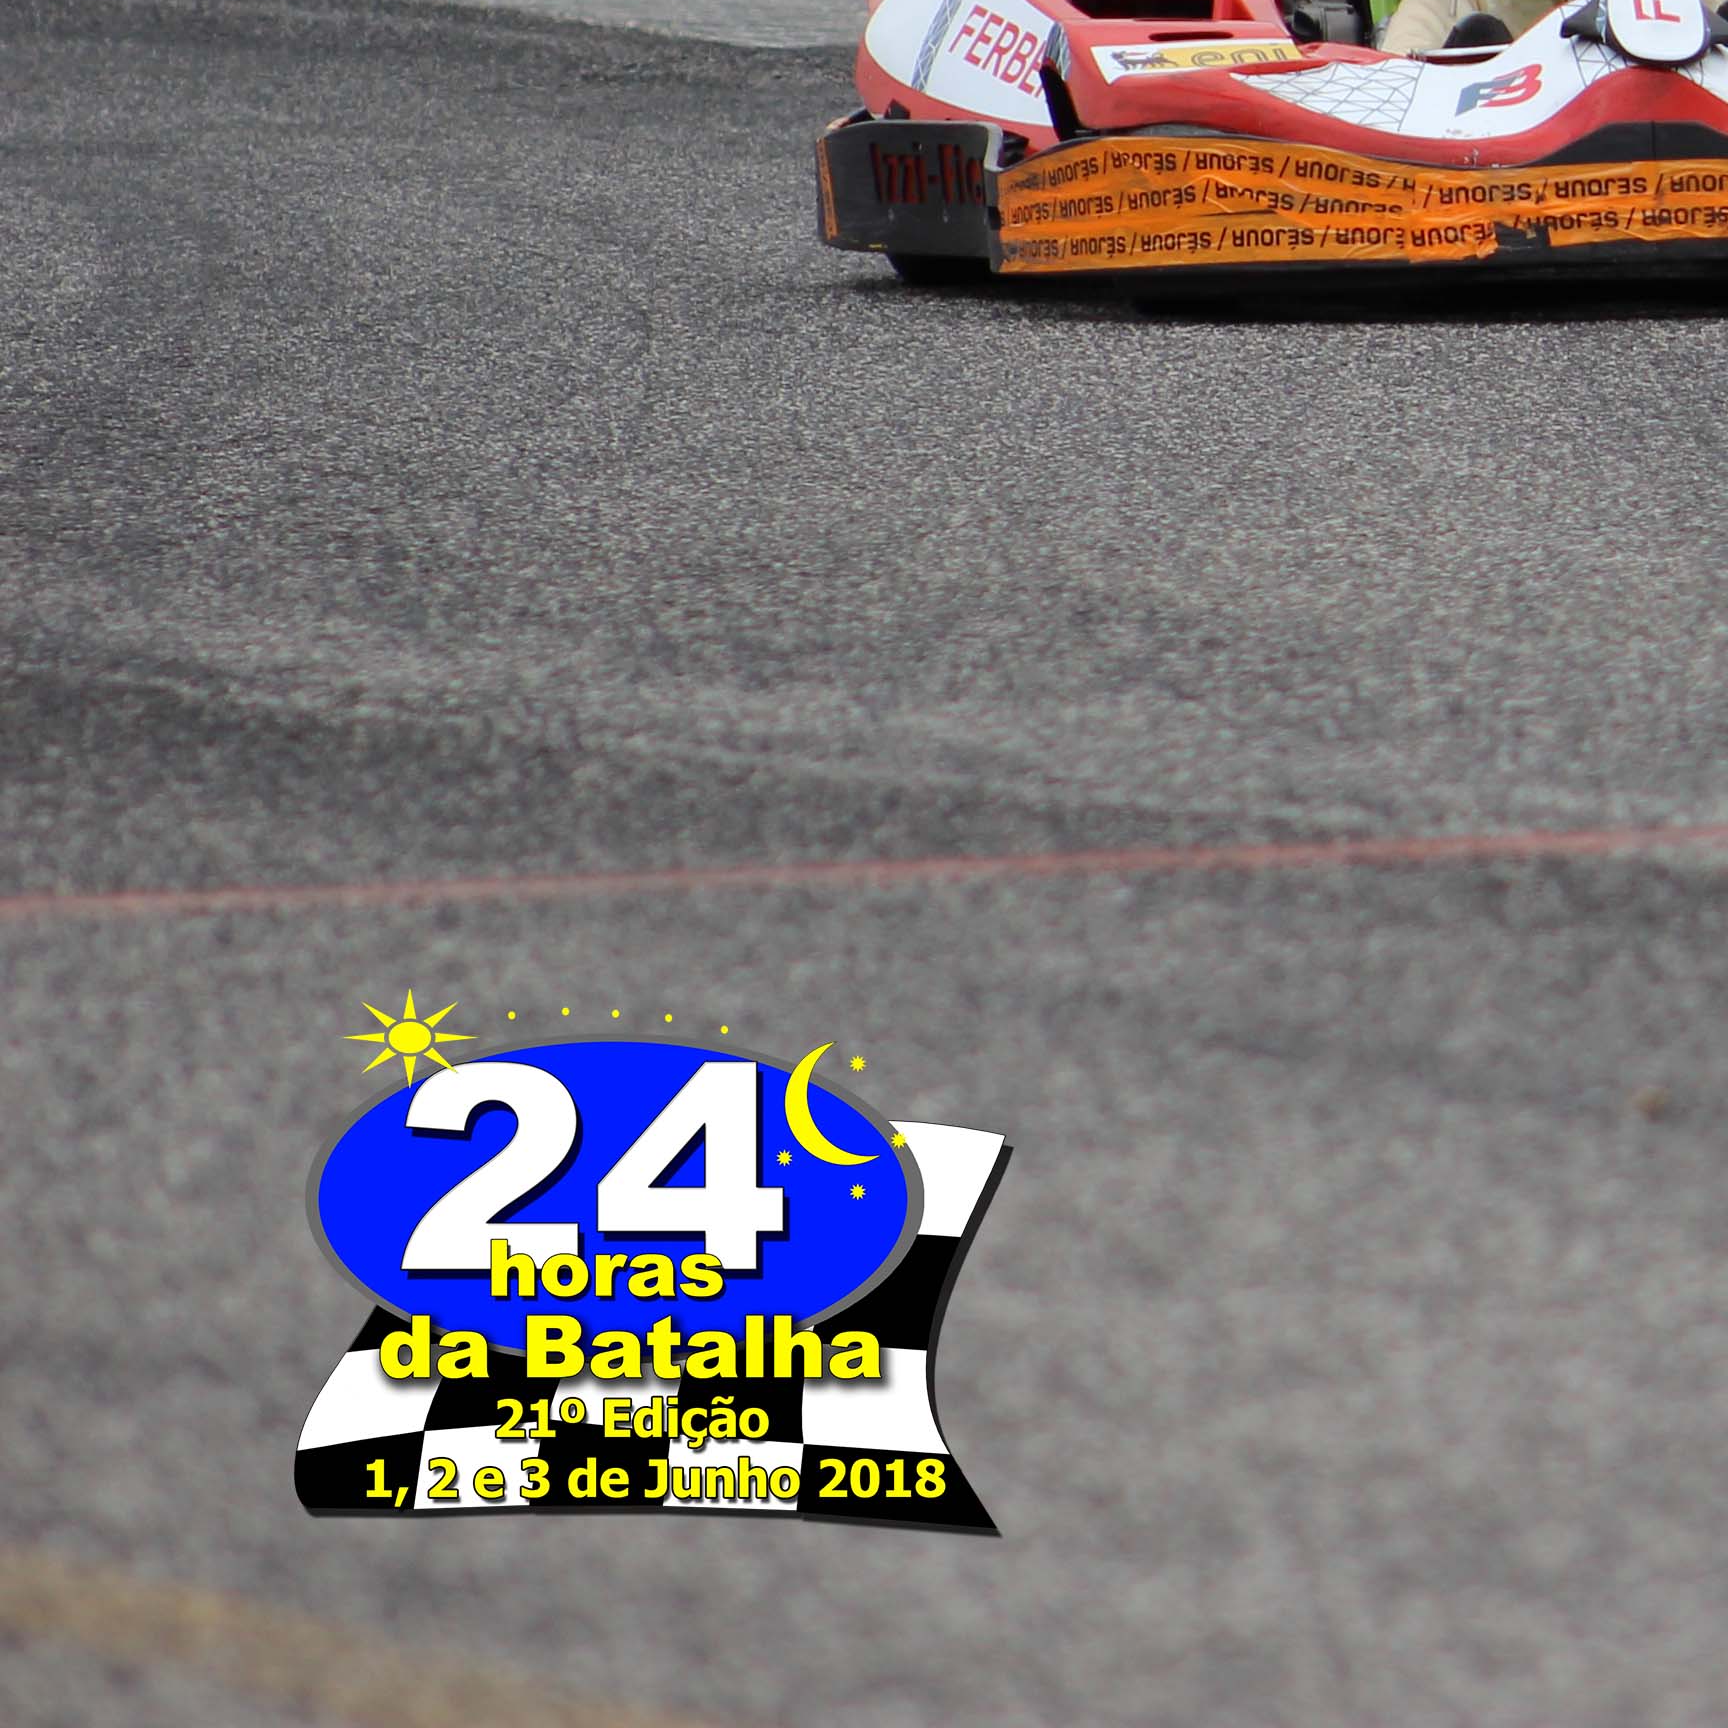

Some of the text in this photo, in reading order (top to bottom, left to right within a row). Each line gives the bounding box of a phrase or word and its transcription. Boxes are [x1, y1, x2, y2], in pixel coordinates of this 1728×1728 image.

[1190, 46, 1289, 68] eni
[1070, 235, 1126, 262] SÉJOUR
[1141, 231, 1211, 255] SÉJOUR
[1232, 228, 1314, 251] SÉJOUR
